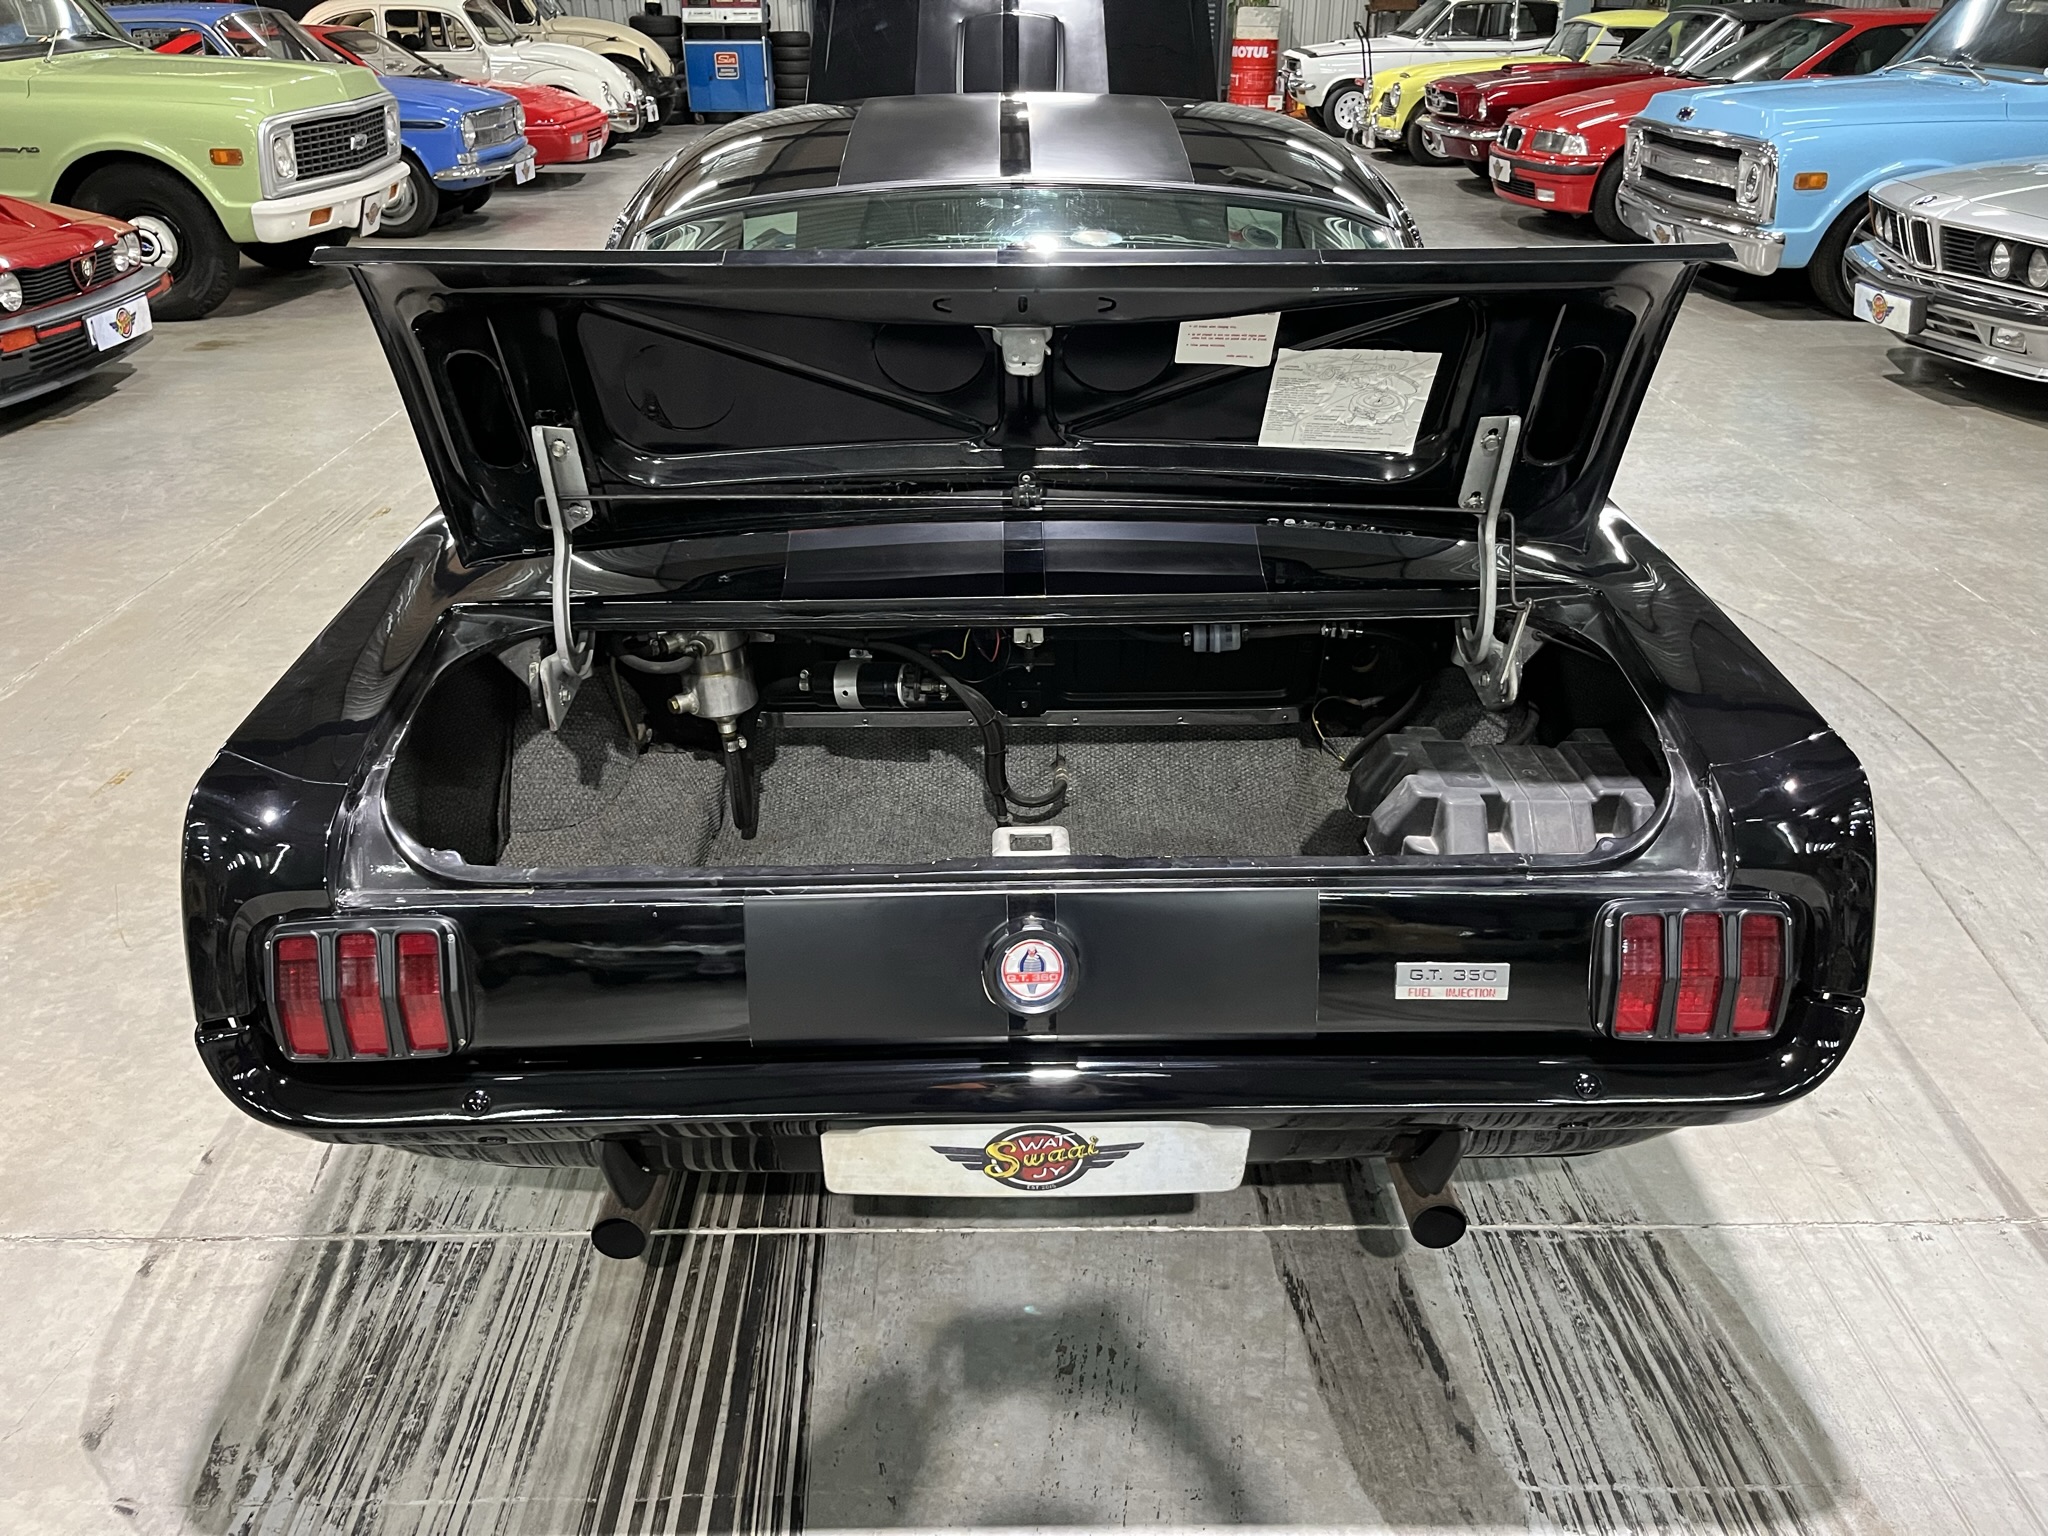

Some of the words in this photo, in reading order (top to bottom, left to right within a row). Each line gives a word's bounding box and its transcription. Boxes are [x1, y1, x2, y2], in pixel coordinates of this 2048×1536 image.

[1232, 46, 1269, 58] MOTUL
[1409, 969, 1443, 981] G.T.
[1453, 969, 1497, 981] 350
[1407, 987, 1433, 998] FUEL
[1445, 987, 1496, 998] INJECTION
[1017, 1132, 1076, 1152] WAT
[984, 1135, 1099, 1178] Swaai
[1033, 1166, 1065, 1178] JY
